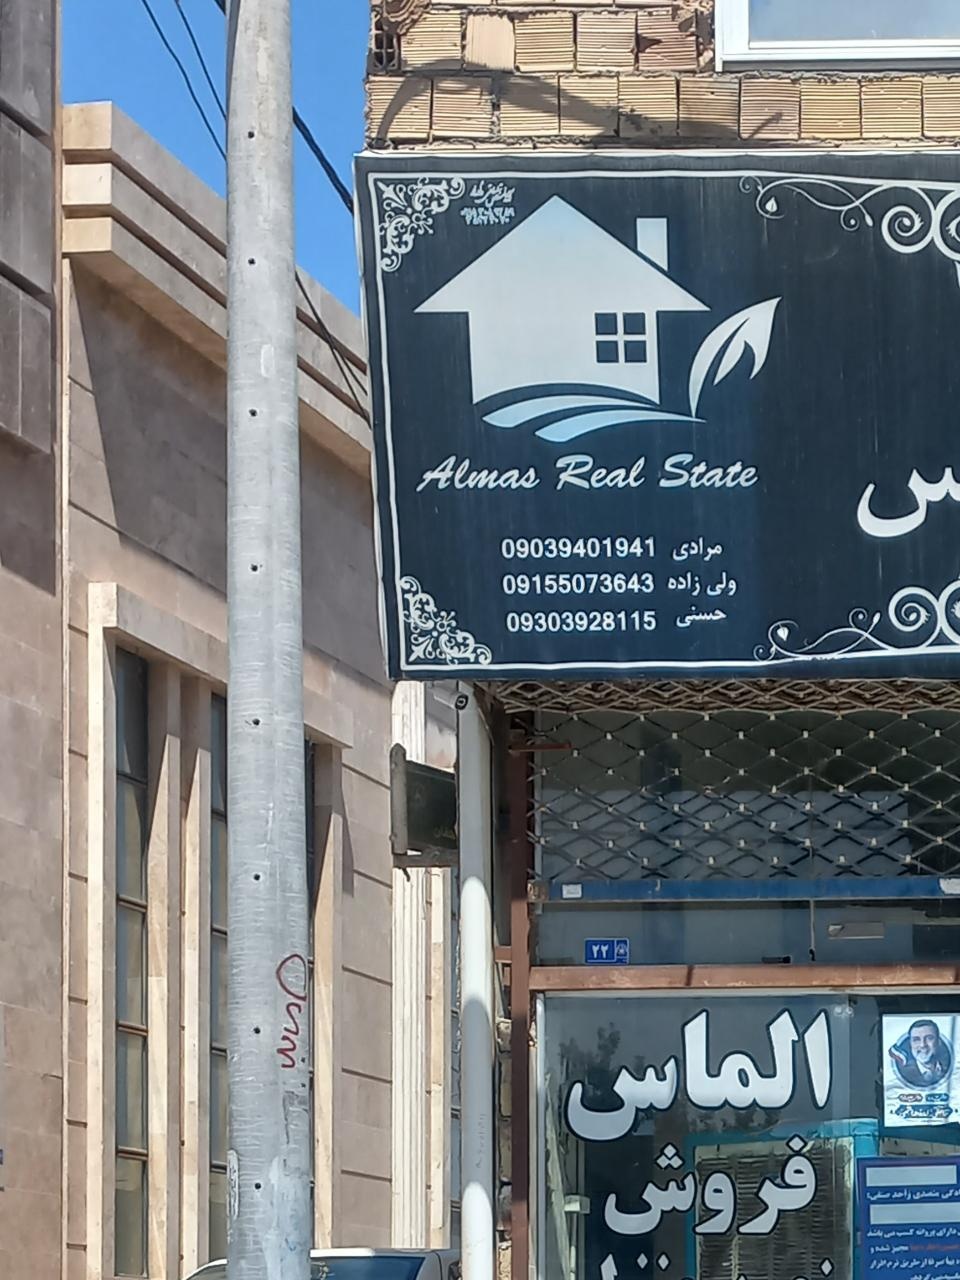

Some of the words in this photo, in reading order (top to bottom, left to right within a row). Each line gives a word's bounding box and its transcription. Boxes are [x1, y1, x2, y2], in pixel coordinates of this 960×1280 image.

[416, 455, 540, 492] Almas
[555, 455, 646, 489] Real
[658, 454, 759, 489] State
[501, 536, 656, 559] 09039401941
[672, 537, 723, 561] مرادی
[502, 572, 655, 595] 09155073643
[667, 571, 701, 596] زاده
[706, 571, 737, 596] ولی
[506, 610, 657, 633] 09303928115
[676, 605, 727, 628] حسنی
[565, 1008, 834, 1141] الماس
[603, 1134, 817, 1235] فروش
